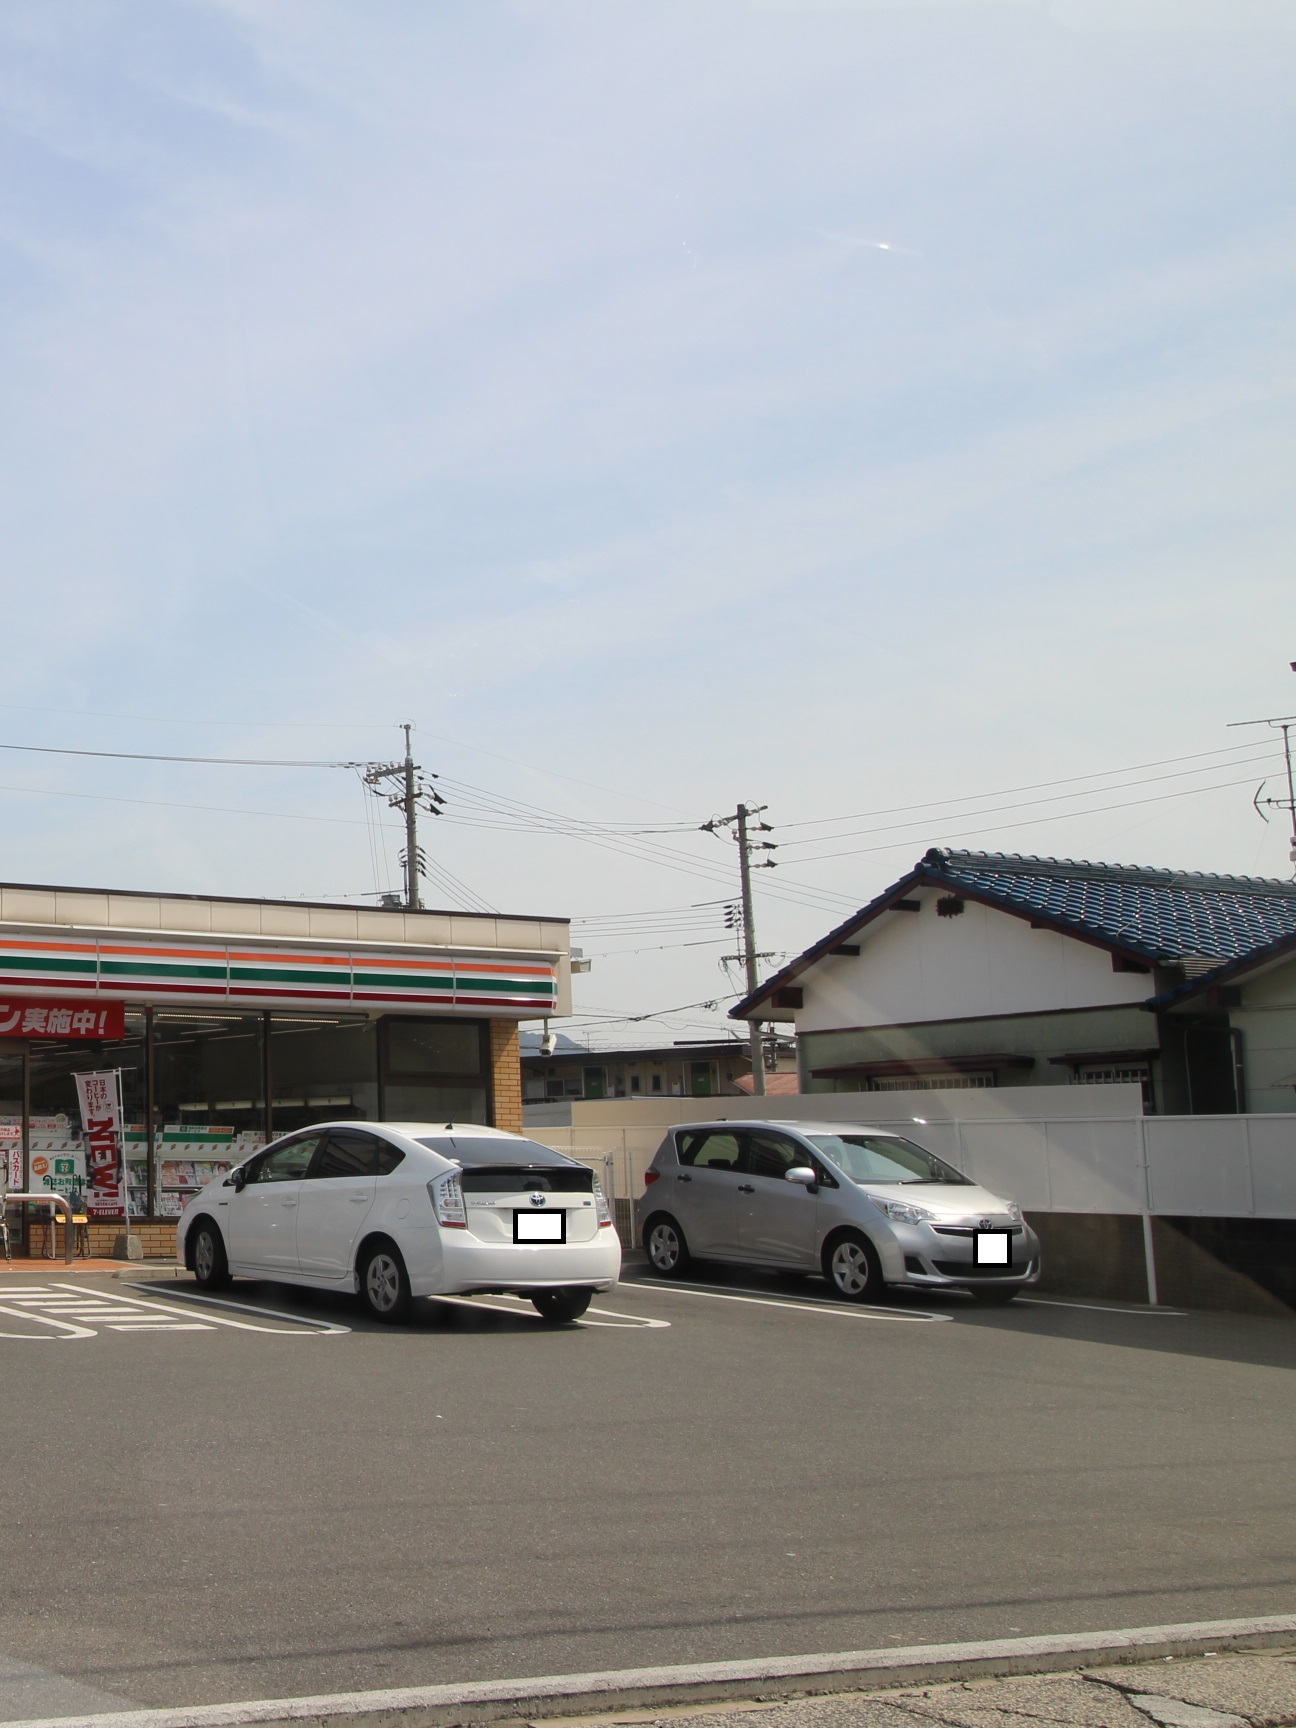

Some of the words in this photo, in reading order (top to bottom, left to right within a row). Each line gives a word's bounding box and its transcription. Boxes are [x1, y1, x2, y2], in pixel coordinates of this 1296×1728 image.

[99, 1079, 108, 1100] 日本の
[87, 1117, 120, 1199] NEW!
